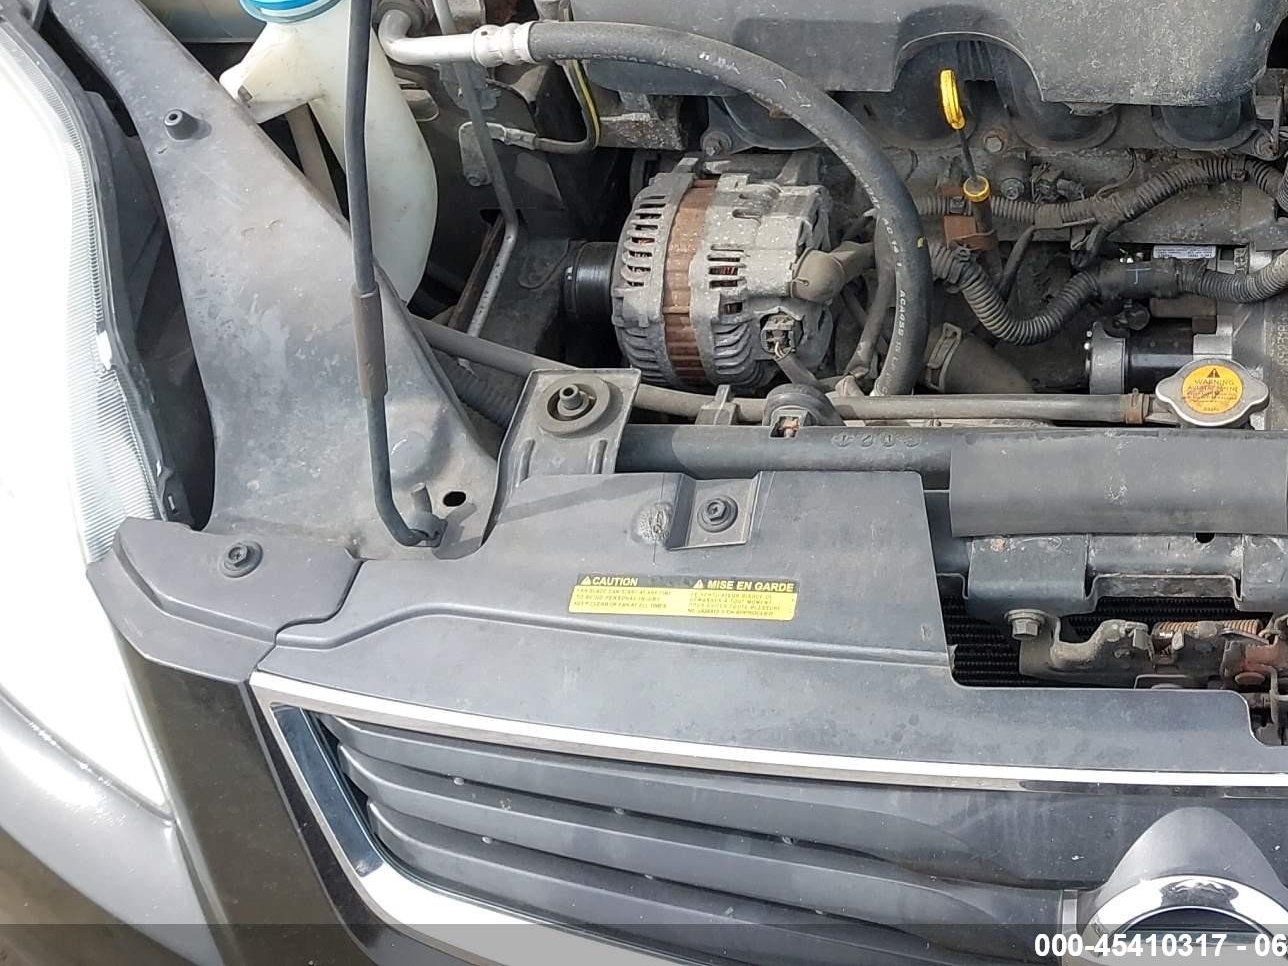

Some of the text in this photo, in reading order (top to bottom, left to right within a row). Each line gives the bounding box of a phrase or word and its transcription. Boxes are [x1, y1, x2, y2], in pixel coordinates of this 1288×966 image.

[592, 576, 638, 587] CAUTION
[707, 579, 795, 592] MISE EN GARDE
